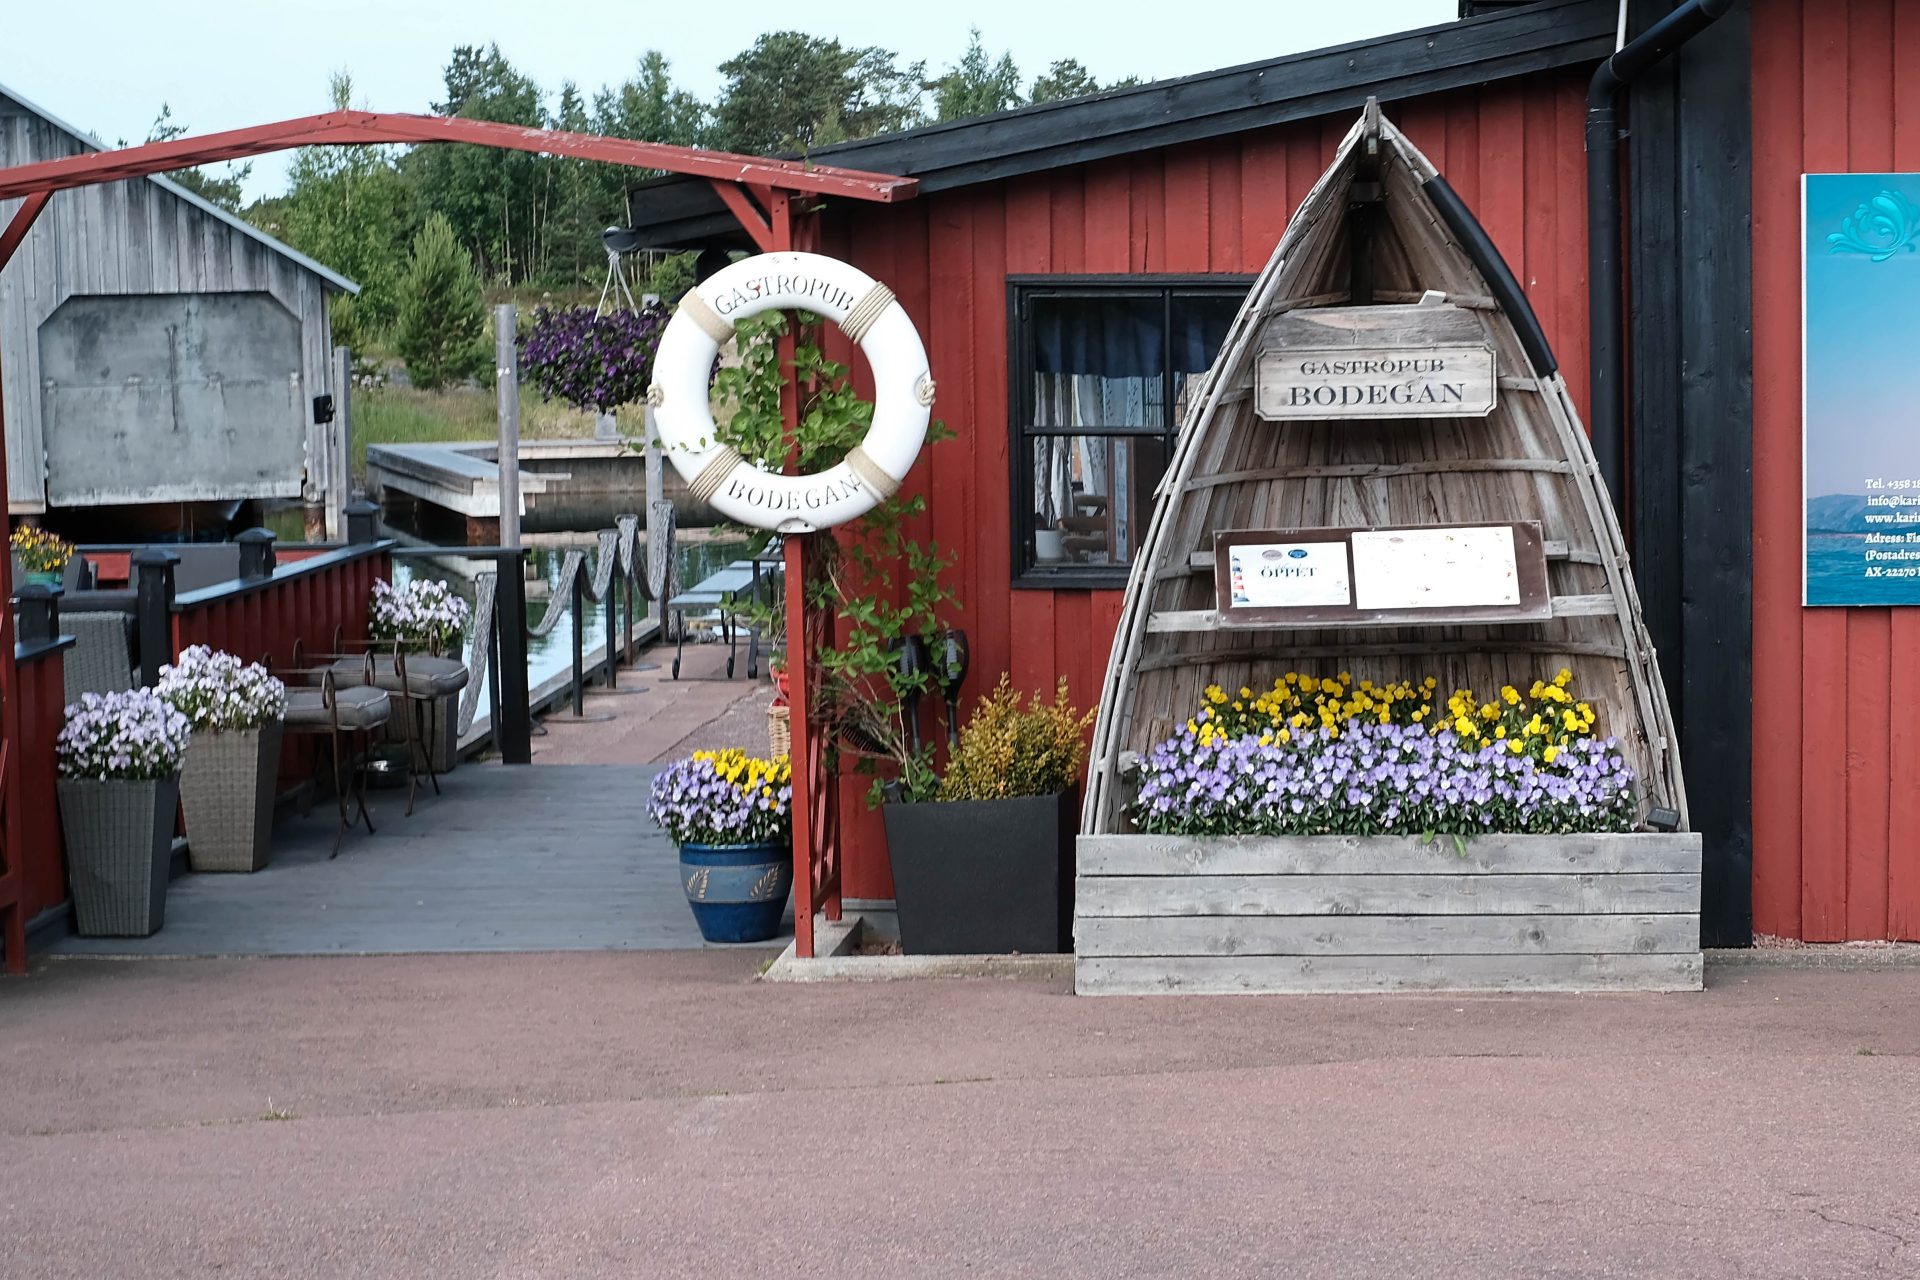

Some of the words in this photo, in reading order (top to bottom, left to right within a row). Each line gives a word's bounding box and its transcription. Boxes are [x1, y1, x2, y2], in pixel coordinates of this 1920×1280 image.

[715, 275, 854, 315] GASTROPUB
[1300, 359, 1445, 375] GASTROPUB
[1288, 383, 1466, 406] BODEGAN
[1865, 478, 1885, 489] Tel.
[1887, 480, 1911, 489] +358
[728, 474, 861, 510] BODEGAN
[1865, 532, 1904, 543] Adress:
[1261, 566, 1317, 577] ÖPPET
[1865, 567, 1916, 577] AX-22270
